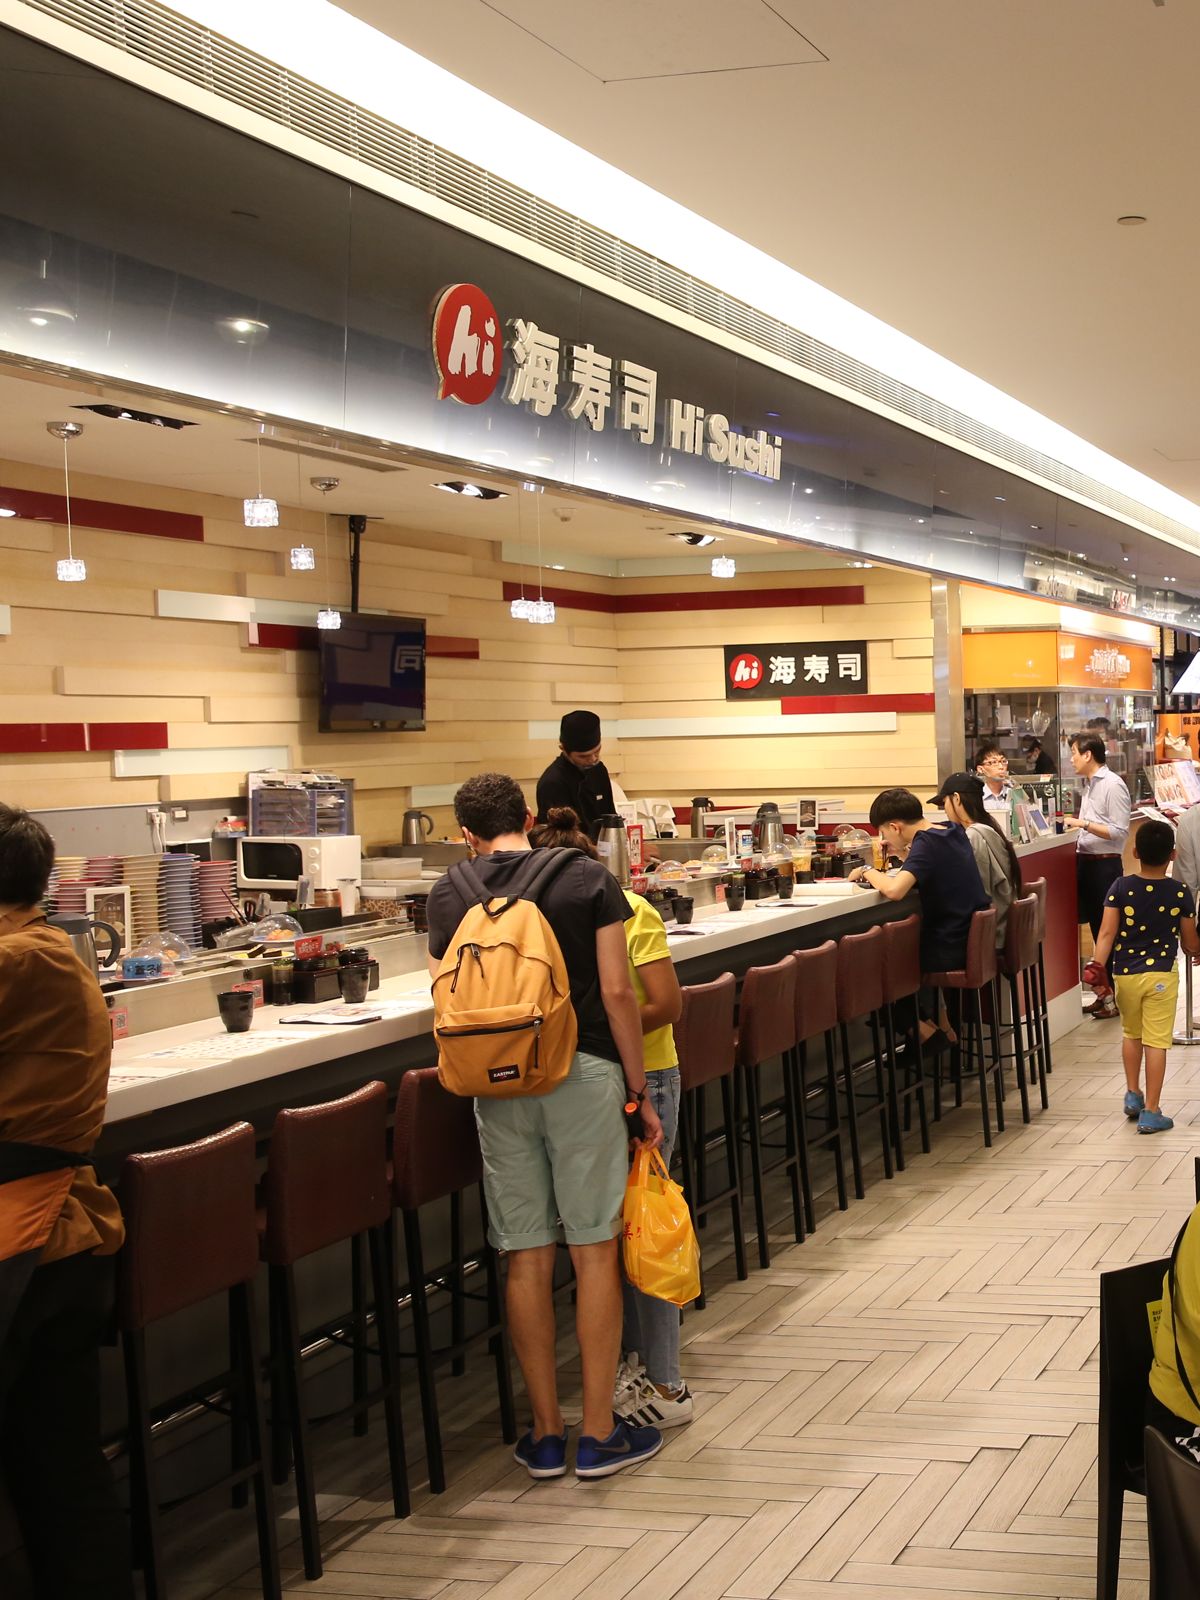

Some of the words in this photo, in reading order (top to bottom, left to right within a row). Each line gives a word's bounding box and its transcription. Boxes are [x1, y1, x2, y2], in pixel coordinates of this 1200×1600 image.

[448, 305, 495, 377] hi
[506, 318, 657, 445] 海寿司
[667, 398, 703, 455] Hi
[707, 413, 783, 480] Sushi
[734, 660, 759, 682] hi
[769, 653, 862, 685] 海寿司
[493, 1070, 516, 1078] EASTPAK
